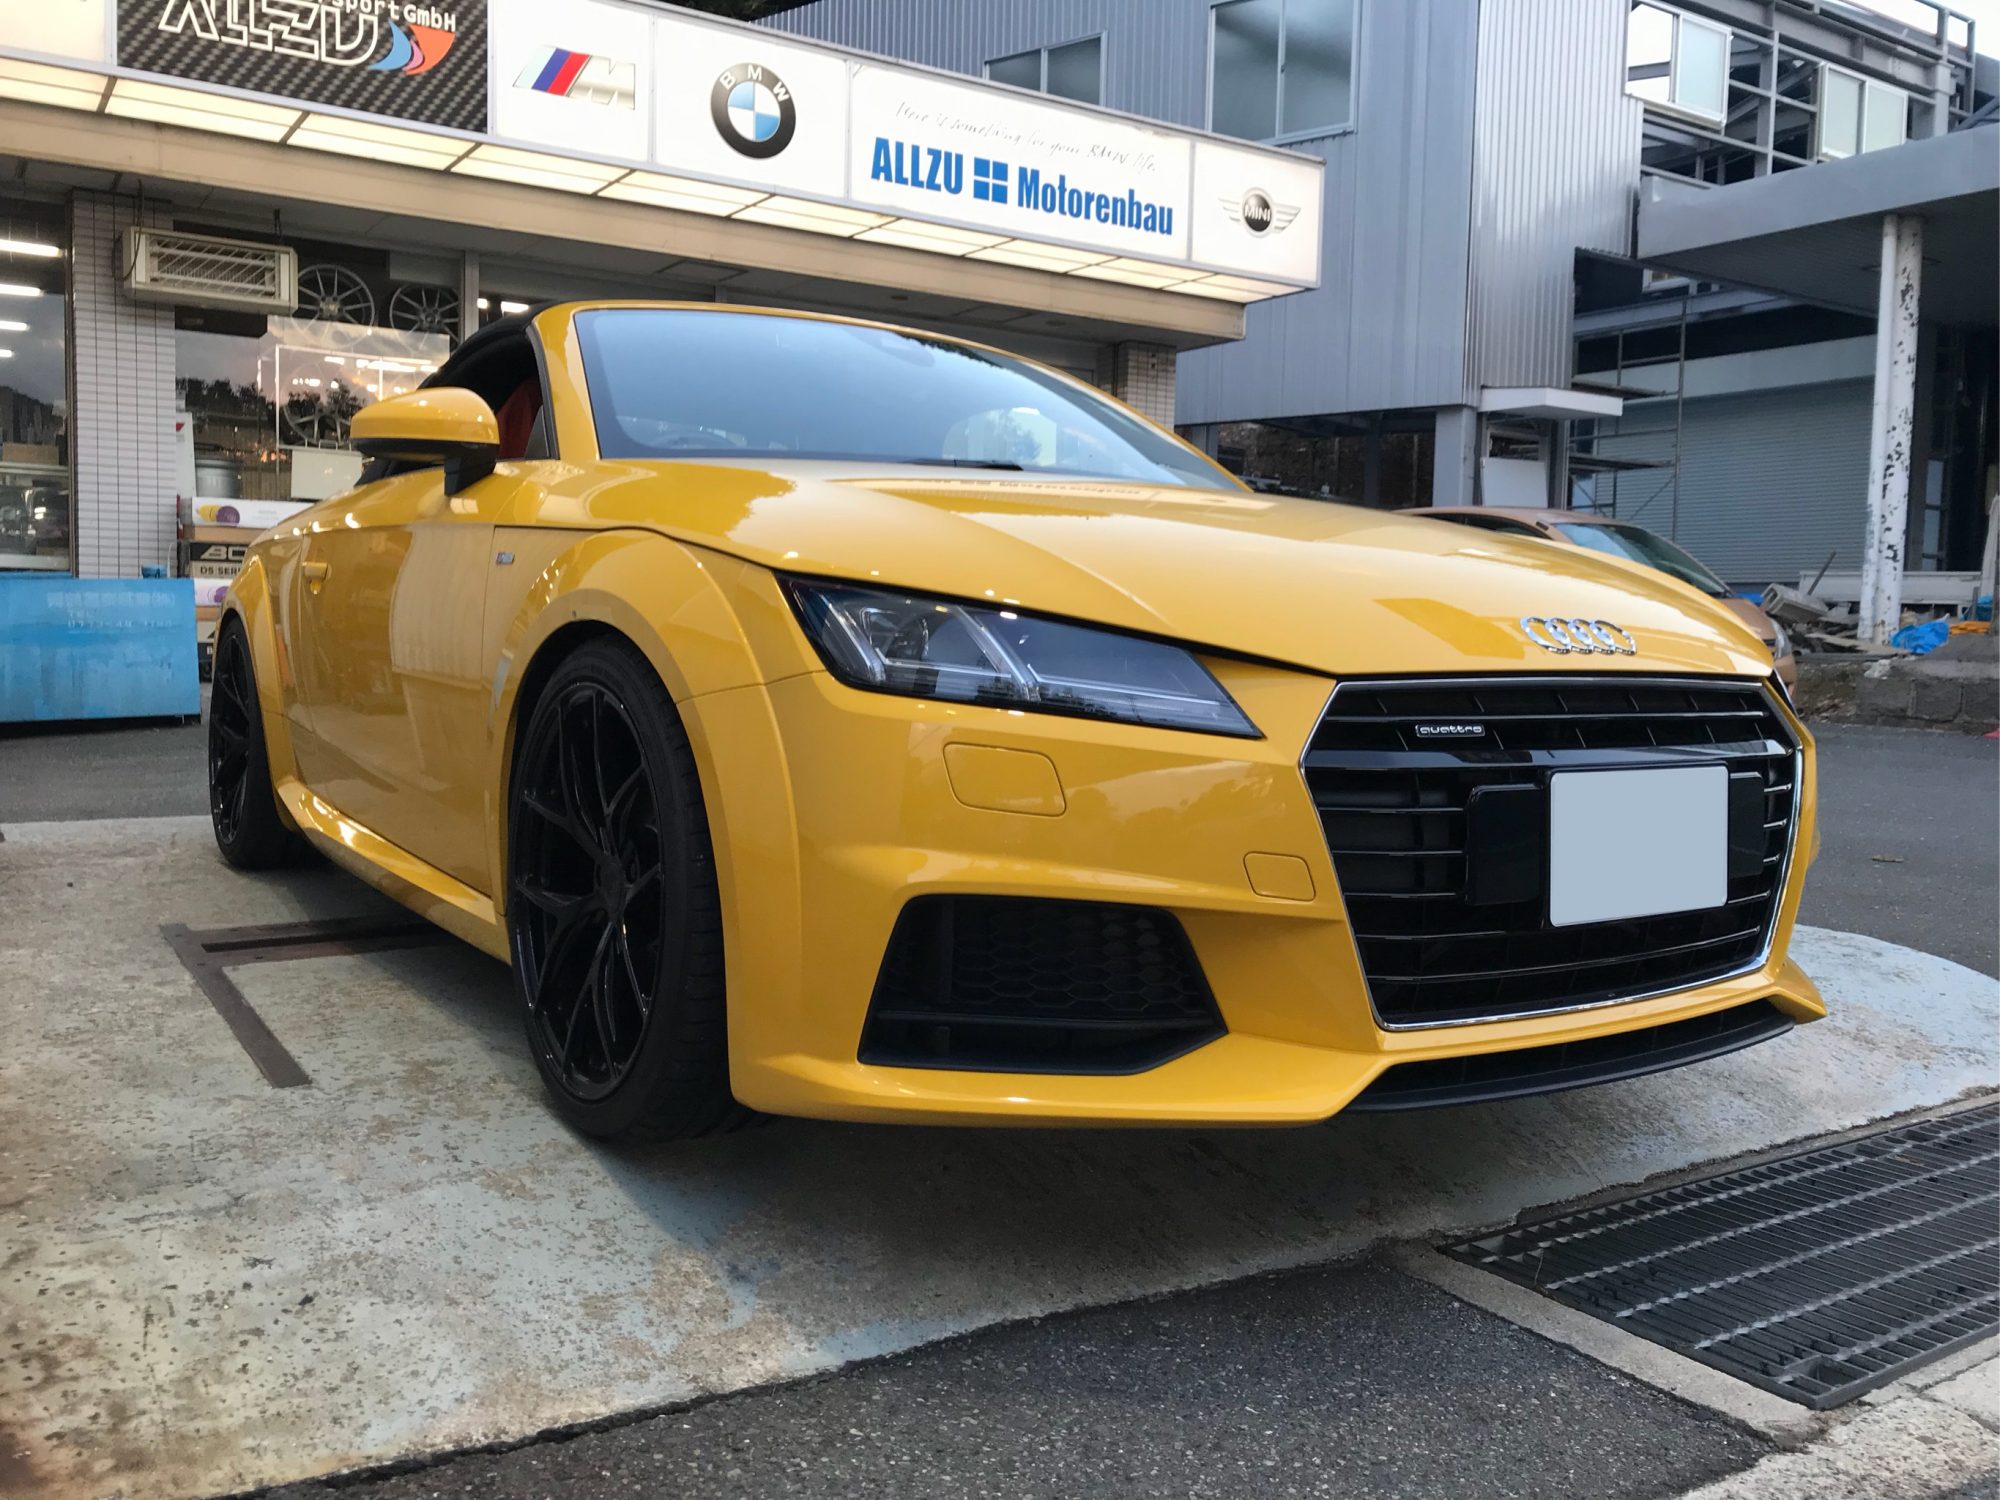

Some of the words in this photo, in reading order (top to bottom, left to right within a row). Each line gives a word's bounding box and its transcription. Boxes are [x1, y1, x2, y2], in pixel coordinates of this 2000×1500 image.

[403, 4, 457, 31] GmbH
[719, 64, 790, 102] BMW
[871, 137, 963, 194] ALLZU
[1018, 166, 1173, 235] Motorenbau
[1244, 204, 1271, 222] MINI
[1420, 725, 1482, 735] quattro
